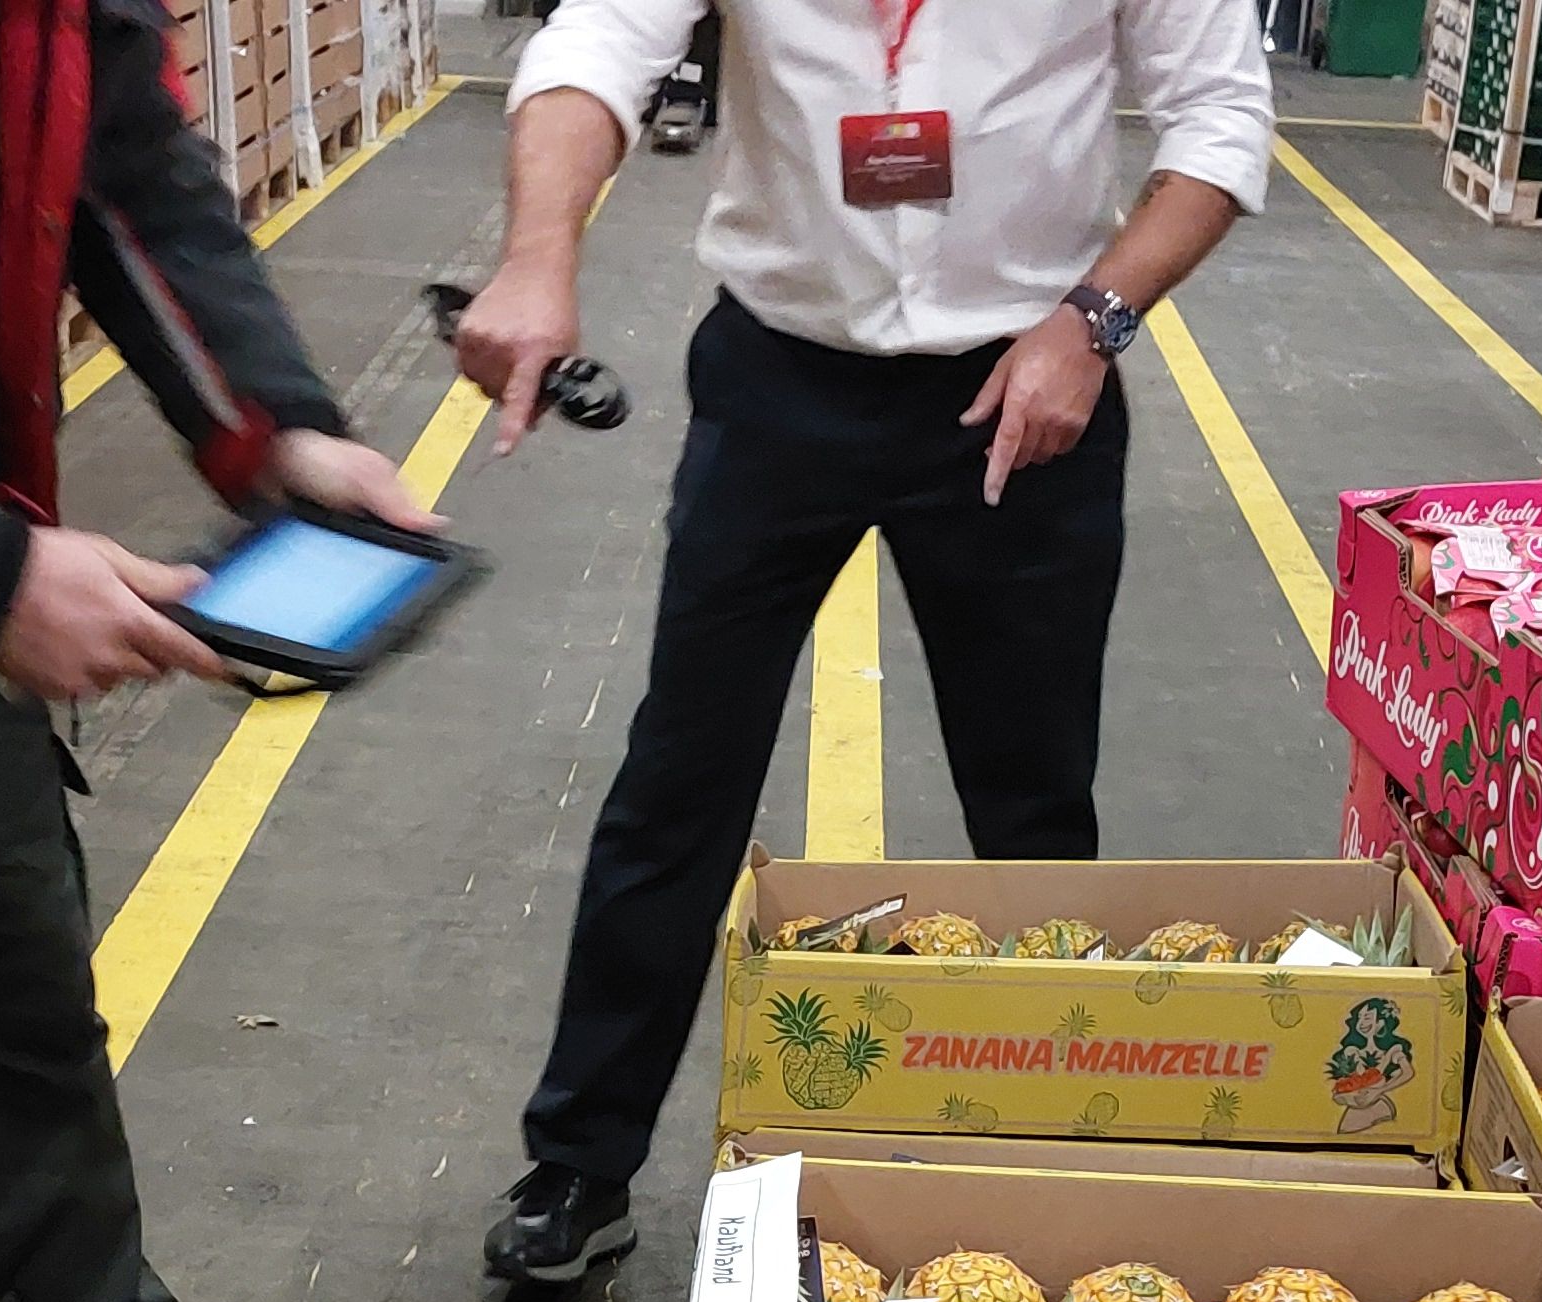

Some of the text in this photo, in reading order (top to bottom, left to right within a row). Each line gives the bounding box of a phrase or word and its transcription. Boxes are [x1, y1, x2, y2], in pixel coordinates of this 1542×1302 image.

[1419, 499, 1542, 526] Pink Lady
[1334, 610, 1443, 769] Pink Lady
[901, 1034, 1268, 1078] ZANANA MAMZELLE
[712, 1215, 746, 1284] Kaufland
